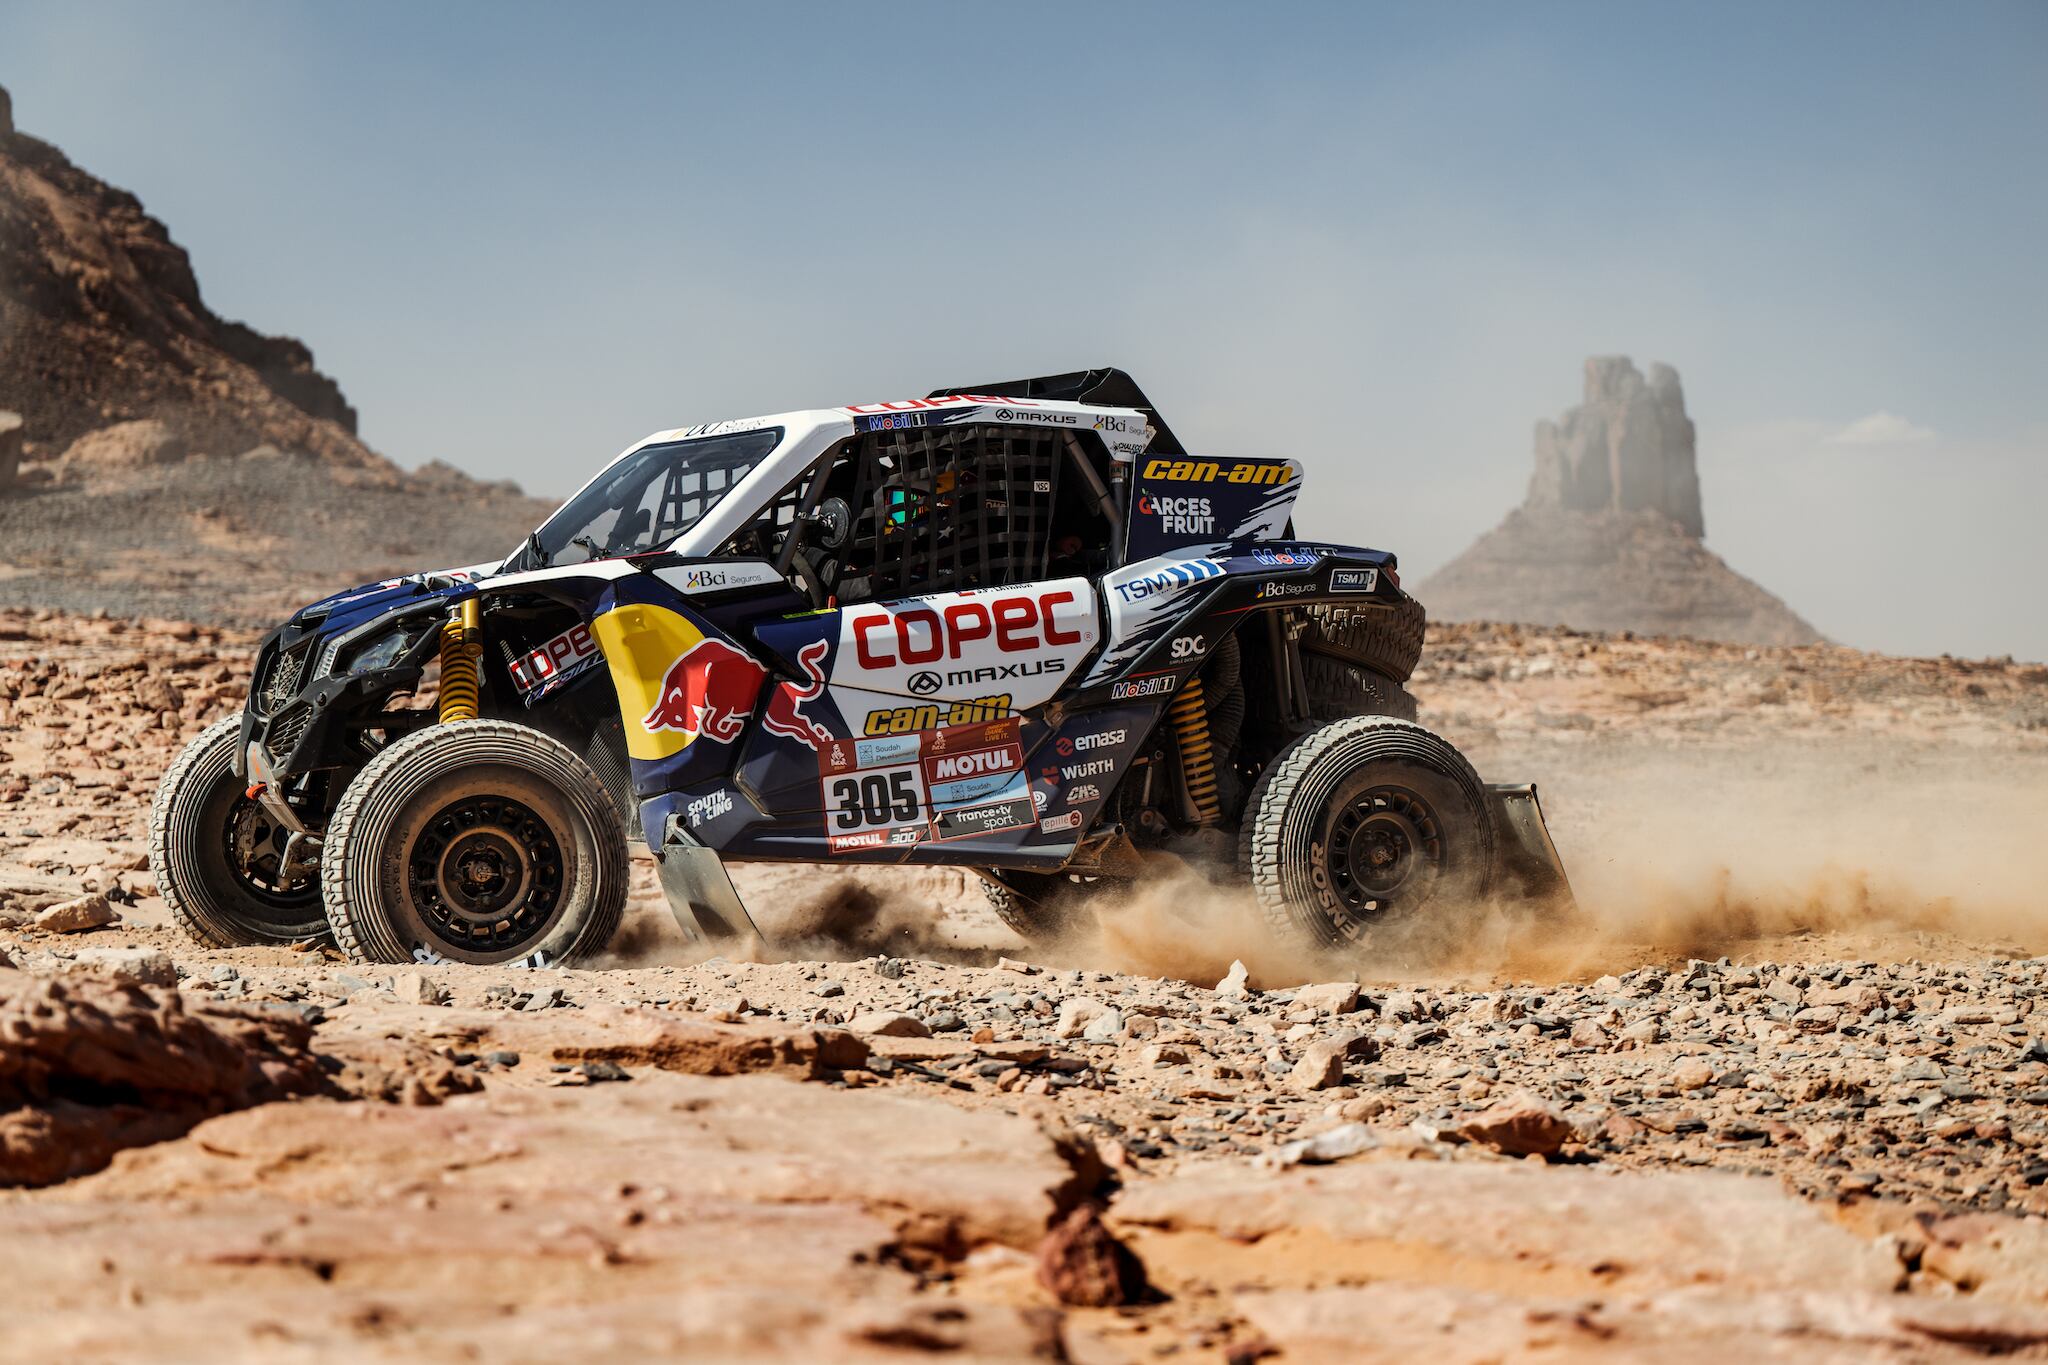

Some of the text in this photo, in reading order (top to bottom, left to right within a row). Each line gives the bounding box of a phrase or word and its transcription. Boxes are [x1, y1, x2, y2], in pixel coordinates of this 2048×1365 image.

[869, 412, 928, 431] Mobil 1
[1016, 412, 1077, 424] MAXUS
[1105, 416, 1126, 432] Bci
[1143, 460, 1293, 484] can-am
[1139, 497, 1211, 516] GARCES
[1163, 516, 1215, 534] FRUIT
[1251, 547, 1319, 566] Mobil
[699, 571, 761, 586] Bci Seguros
[1114, 573, 1172, 602] TSM
[1337, 574, 1358, 584] TSM
[1265, 582, 1316, 597] Bci Seguros
[1171, 634, 1206, 658] SDC
[511, 624, 596, 690] COPE
[947, 658, 1065, 686] MAXUS
[1111, 675, 1176, 699] Mobil 1
[864, 693, 1012, 736] can-am
[875, 744, 901, 753] Soudah
[1075, 729, 1125, 751] emasa
[936, 749, 1013, 779] MOTUL
[966, 783, 991, 792] Soudah
[1066, 784, 1099, 801] CHS
[687, 788, 726, 817] SOUTH
[833, 771, 919, 829] 305
[692, 797, 733, 828] RCING
[984, 815, 1014, 834] sport
[836, 834, 883, 849] MOTUL
